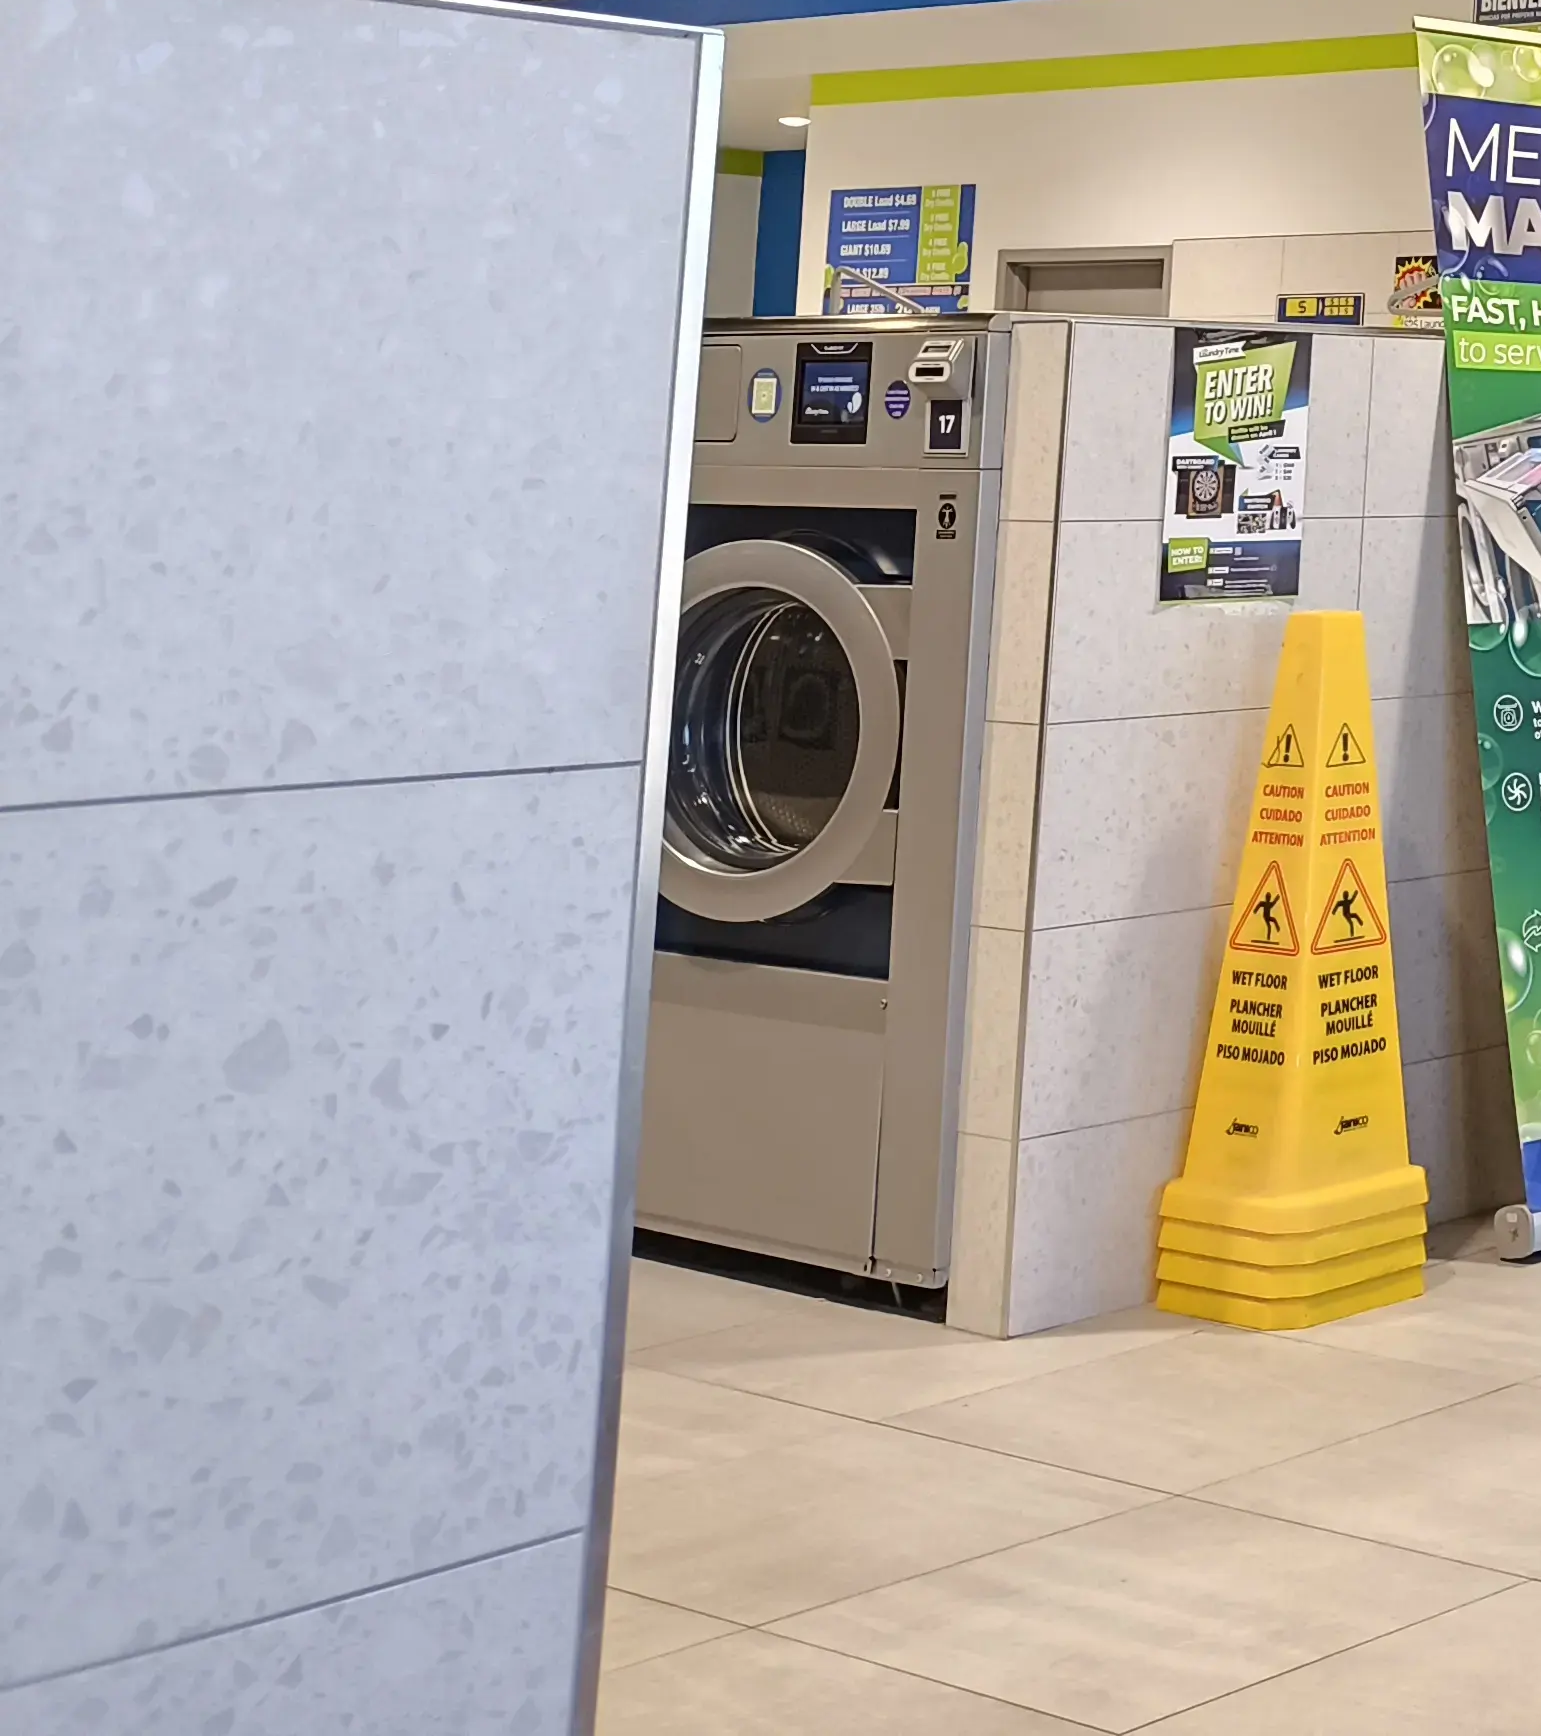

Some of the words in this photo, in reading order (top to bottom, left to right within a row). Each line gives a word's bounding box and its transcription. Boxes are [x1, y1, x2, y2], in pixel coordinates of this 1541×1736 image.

[1451, 295, 1526, 330] FAST,
[1458, 336, 1486, 363] to
[1204, 364, 1275, 401] ENTER
[1205, 401, 1228, 425] TO
[1230, 394, 1274, 421] WIN!
[938, 415, 955, 433] 17
[1171, 548, 1191, 556] HOW
[1262, 784, 1304, 799] CAUTION
[1325, 782, 1370, 798] CAUTION
[1259, 808, 1303, 823] CUIDADO
[1324, 805, 1371, 822] CUIDADO
[1252, 831, 1304, 847] ATTENTION
[1319, 827, 1376, 847] ATTENTION
[1232, 970, 1254, 986] WET
[1254, 972, 1288, 990] FLOOR
[1318, 971, 1343, 989] WET
[1343, 965, 1379, 984] FLOOR
[1230, 999, 1282, 1019] PLANCHER
[1320, 993, 1377, 1017] PLANCHER
[1231, 1019, 1277, 1038] MOUILLÉ
[1325, 1010, 1373, 1036] MOUILLÉ
[1216, 1043, 1240, 1060] PISO
[1241, 1047, 1285, 1066] MOJADO
[1312, 1047, 1339, 1065] PISO
[1340, 1037, 1387, 1060] MOJADO
